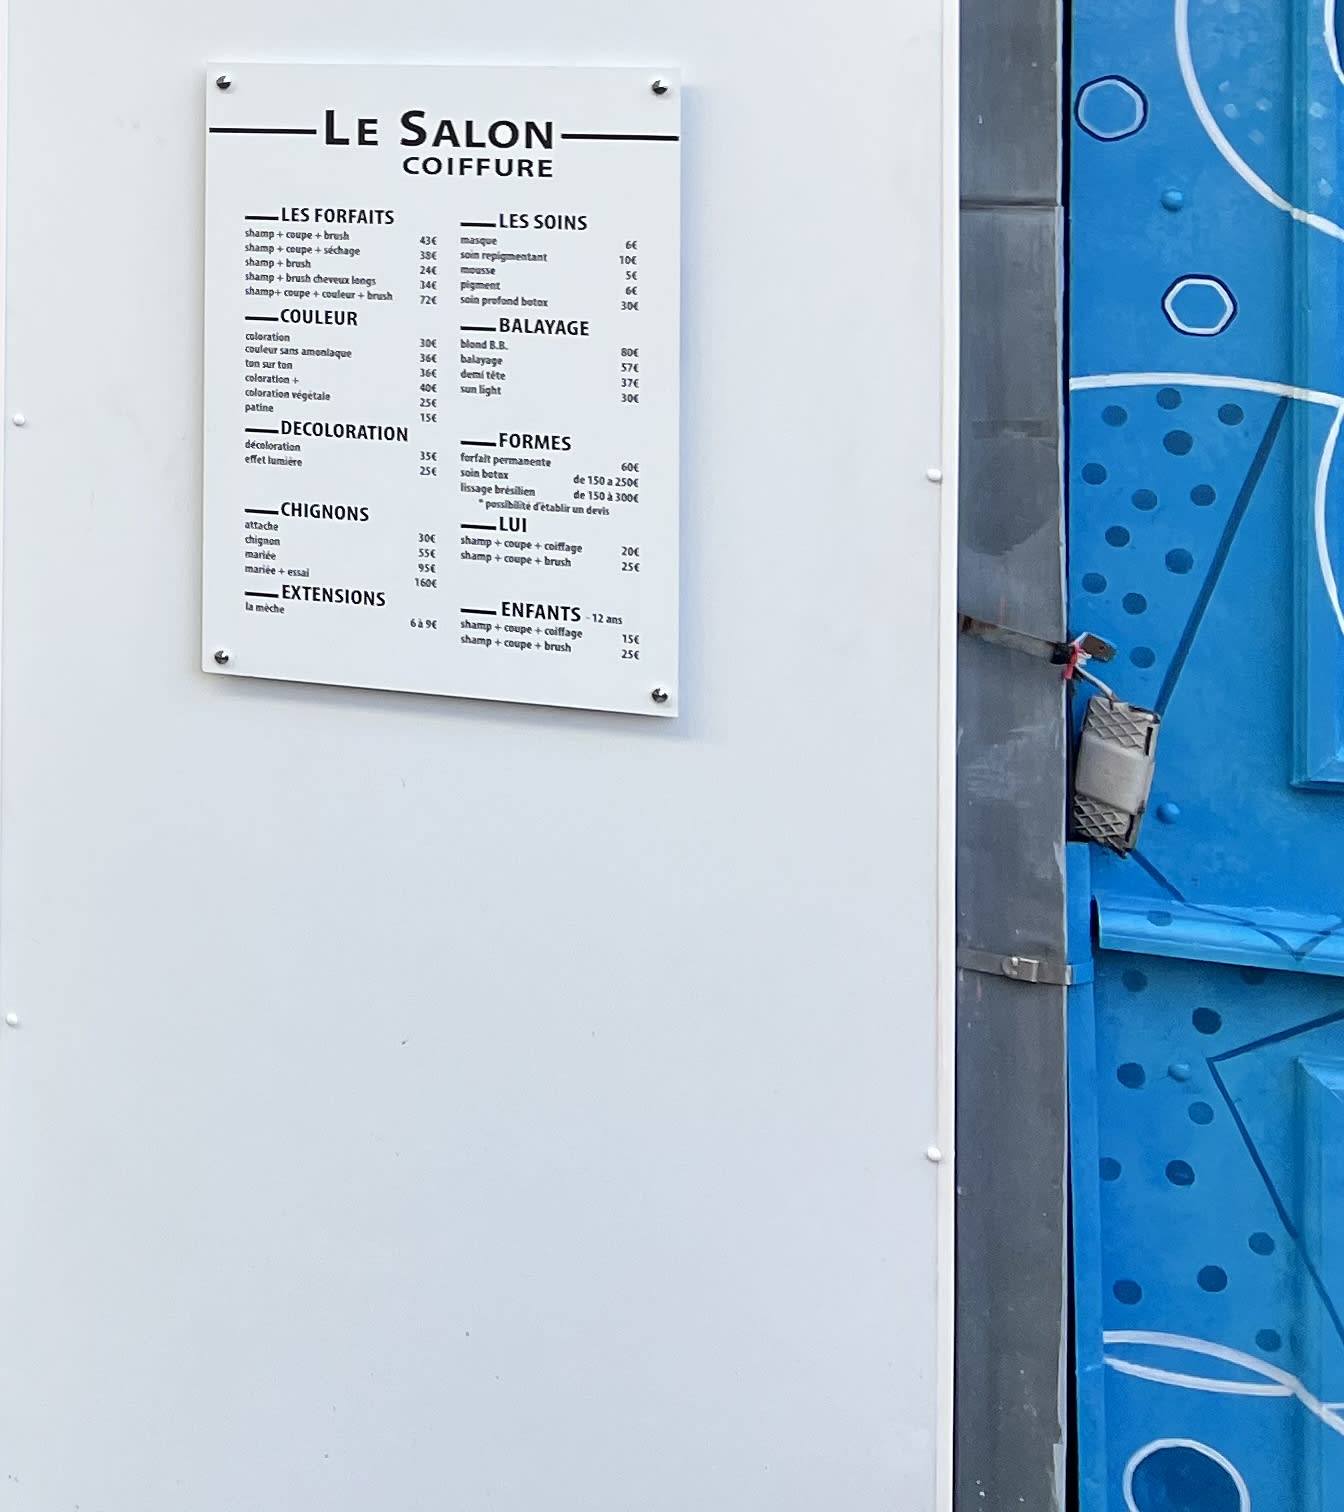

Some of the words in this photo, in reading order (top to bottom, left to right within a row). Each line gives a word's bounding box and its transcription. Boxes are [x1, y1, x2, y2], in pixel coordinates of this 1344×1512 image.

[402, 157, 553, 178] COIFFURE
[282, 207, 309, 222] LES
[315, 208, 394, 225] FORFAITS
[499, 213, 529, 228] LES
[534, 214, 587, 230] SOINS
[245, 229, 274, 239] shamp
[286, 231, 312, 240] coupe
[324, 230, 350, 240] brush
[419, 236, 437, 245] 43€
[626, 240, 638, 250] 6€
[245, 243, 274, 253] shamp
[286, 246, 312, 254] coupe
[245, 257, 274, 268] shamp
[286, 259, 311, 268] brush
[619, 255, 637, 264] 10€
[419, 266, 437, 275] 24€
[626, 271, 638, 280] 5€
[245, 272, 274, 282] shamp
[286, 273, 311, 283] brush
[284, 289, 310, 298] coupe
[322, 290, 355, 299] couleur
[367, 291, 393, 300] brush
[419, 295, 437, 305] 72€
[621, 301, 639, 311] 30€
[280, 309, 358, 326] COULEUR
[499, 318, 590, 336] BALAYAGE
[245, 332, 290, 342] coloration
[419, 338, 437, 348] 30€
[245, 345, 278, 355] couleur
[280, 346, 299, 355] sans
[621, 348, 639, 357] 80€
[245, 359, 260, 368] ton
[278, 361, 293, 369] ton
[460, 354, 503, 367] balayage
[621, 363, 639, 372] 57€
[245, 374, 289, 384] coloration
[621, 378, 639, 388] 37€
[245, 388, 289, 399] coloration
[621, 393, 639, 403] 30€
[245, 403, 274, 413] patine
[419, 398, 437, 408] 25€
[420, 413, 437, 422] 15€
[281, 420, 408, 441] DECOLORATION
[245, 440, 301, 451] décoloration
[499, 432, 571, 451] FORMES
[245, 454, 266, 465] effet
[420, 451, 437, 461] 35€
[419, 466, 437, 476] 25€
[621, 463, 639, 472] 60€
[460, 469, 480, 478] soin
[573, 475, 585, 484] de
[588, 476, 605, 485] 150
[615, 477, 639, 487] 250€
[573, 490, 585, 500] de
[588, 491, 605, 501] 150
[615, 493, 639, 503] 300€
[281, 502, 369, 522] CHIGNONS
[245, 521, 279, 531] attache
[499, 516, 527, 532] LUI
[245, 535, 280, 546] chignon
[418, 533, 436, 543] 30€
[460, 536, 492, 548] shamp
[504, 540, 532, 551] coupe
[418, 548, 436, 558] 55€
[622, 546, 639, 556] 20€
[460, 551, 492, 563] shamp
[504, 555, 532, 566] coupe
[544, 556, 571, 567] brush
[418, 564, 436, 573] 95€
[622, 562, 640, 572] 25€
[415, 578, 437, 588] 160€
[282, 584, 385, 607] EXTENSIONS
[246, 602, 253, 611] la
[502, 601, 581, 622] ENFANTS
[592, 613, 604, 623] 12
[606, 615, 622, 624] ans
[410, 619, 416, 627] 6
[426, 620, 437, 629] 9€
[460, 620, 492, 632] shamp
[504, 624, 532, 635] coupe
[460, 635, 492, 647] shamp
[504, 639, 532, 650] coupe
[544, 641, 571, 652] brush
[622, 634, 640, 644] 15€
[622, 650, 640, 660] 25€
